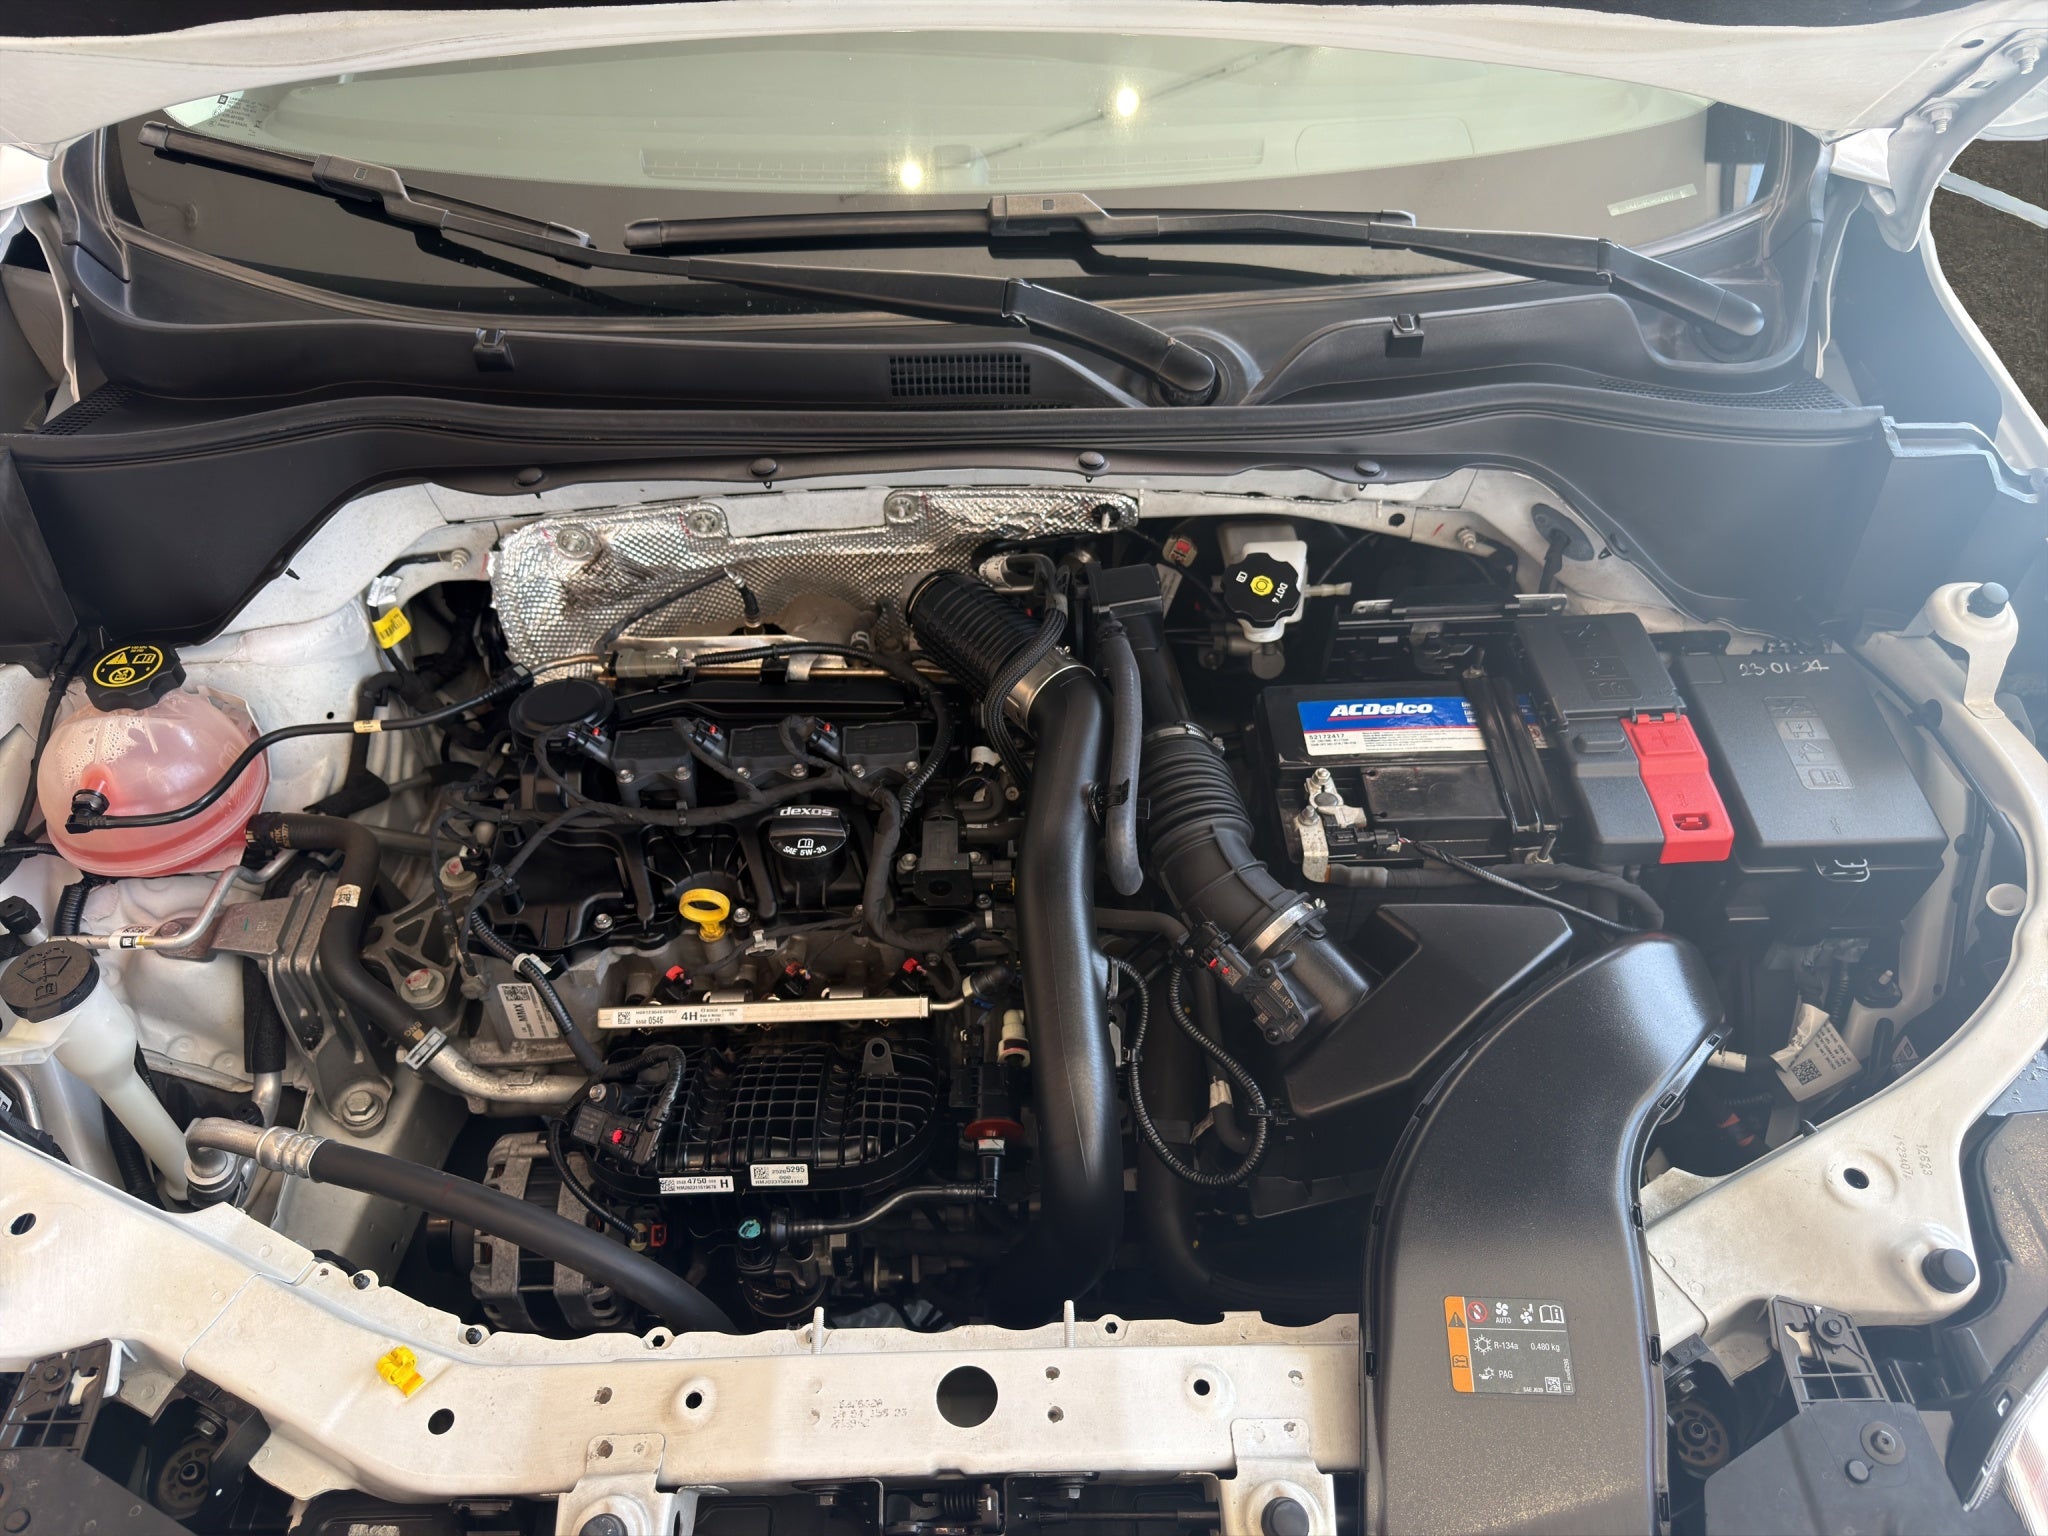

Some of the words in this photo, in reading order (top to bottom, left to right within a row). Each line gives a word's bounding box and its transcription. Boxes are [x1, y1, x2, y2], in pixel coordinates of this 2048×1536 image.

[1275, 582, 1289, 599] DOT
[1329, 702, 1433, 717] ACDelco
[779, 806, 833, 817] dexos
[782, 845, 798, 855] SAE
[799, 845, 827, 856] 5W-30
[648, 1015, 664, 1025] 0546
[681, 1011, 699, 1021] 4H
[686, 1177, 707, 1185] 4750
[720, 1179, 729, 1189] H
[1495, 1316, 1512, 1324] AUTO
[1493, 1341, 1519, 1350] R-134a
[1530, 1342, 1550, 1351] 0.480
[1551, 1343, 1561, 1352] kg
[1498, 1369, 1513, 1379] PAG
